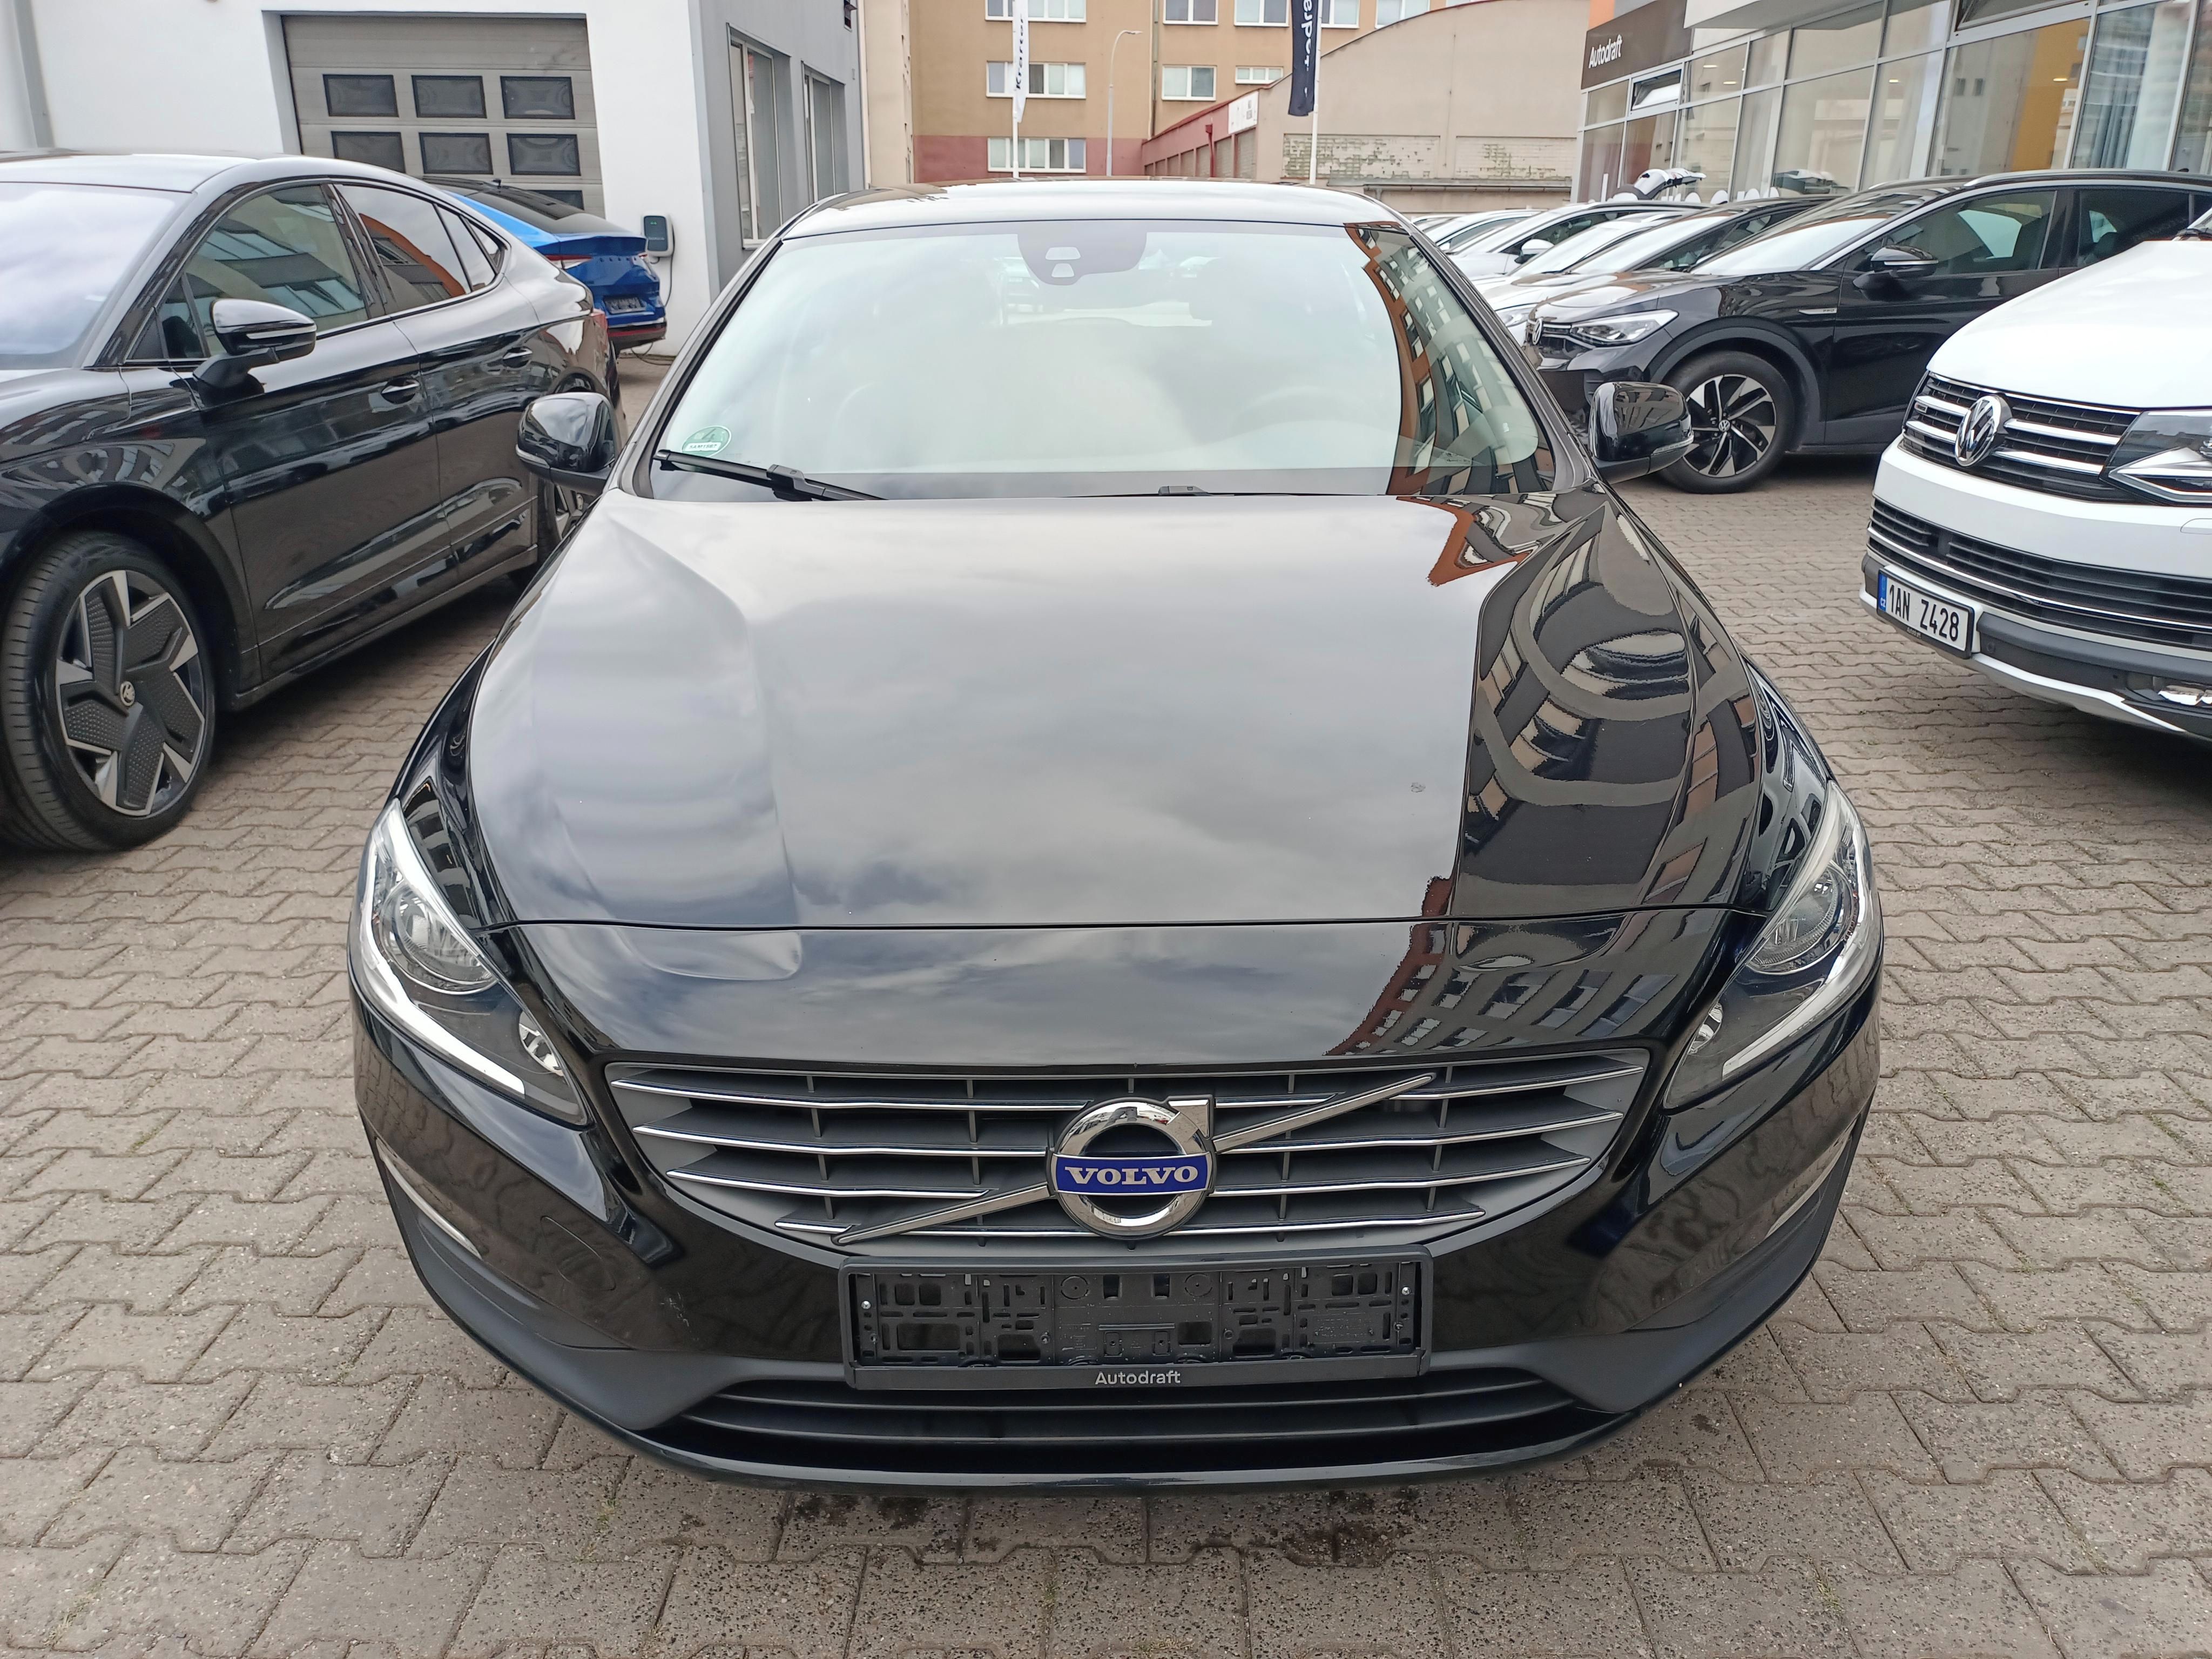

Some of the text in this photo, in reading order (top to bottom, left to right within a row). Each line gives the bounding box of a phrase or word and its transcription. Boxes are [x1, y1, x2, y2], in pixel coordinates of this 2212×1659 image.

[1588, 34, 1623, 69] Autodraft
[1890, 584, 1959, 642] 1AN Z428
[1064, 1165, 1198, 1185] VOLVO
[1095, 1370, 1181, 1385] Autodraft
